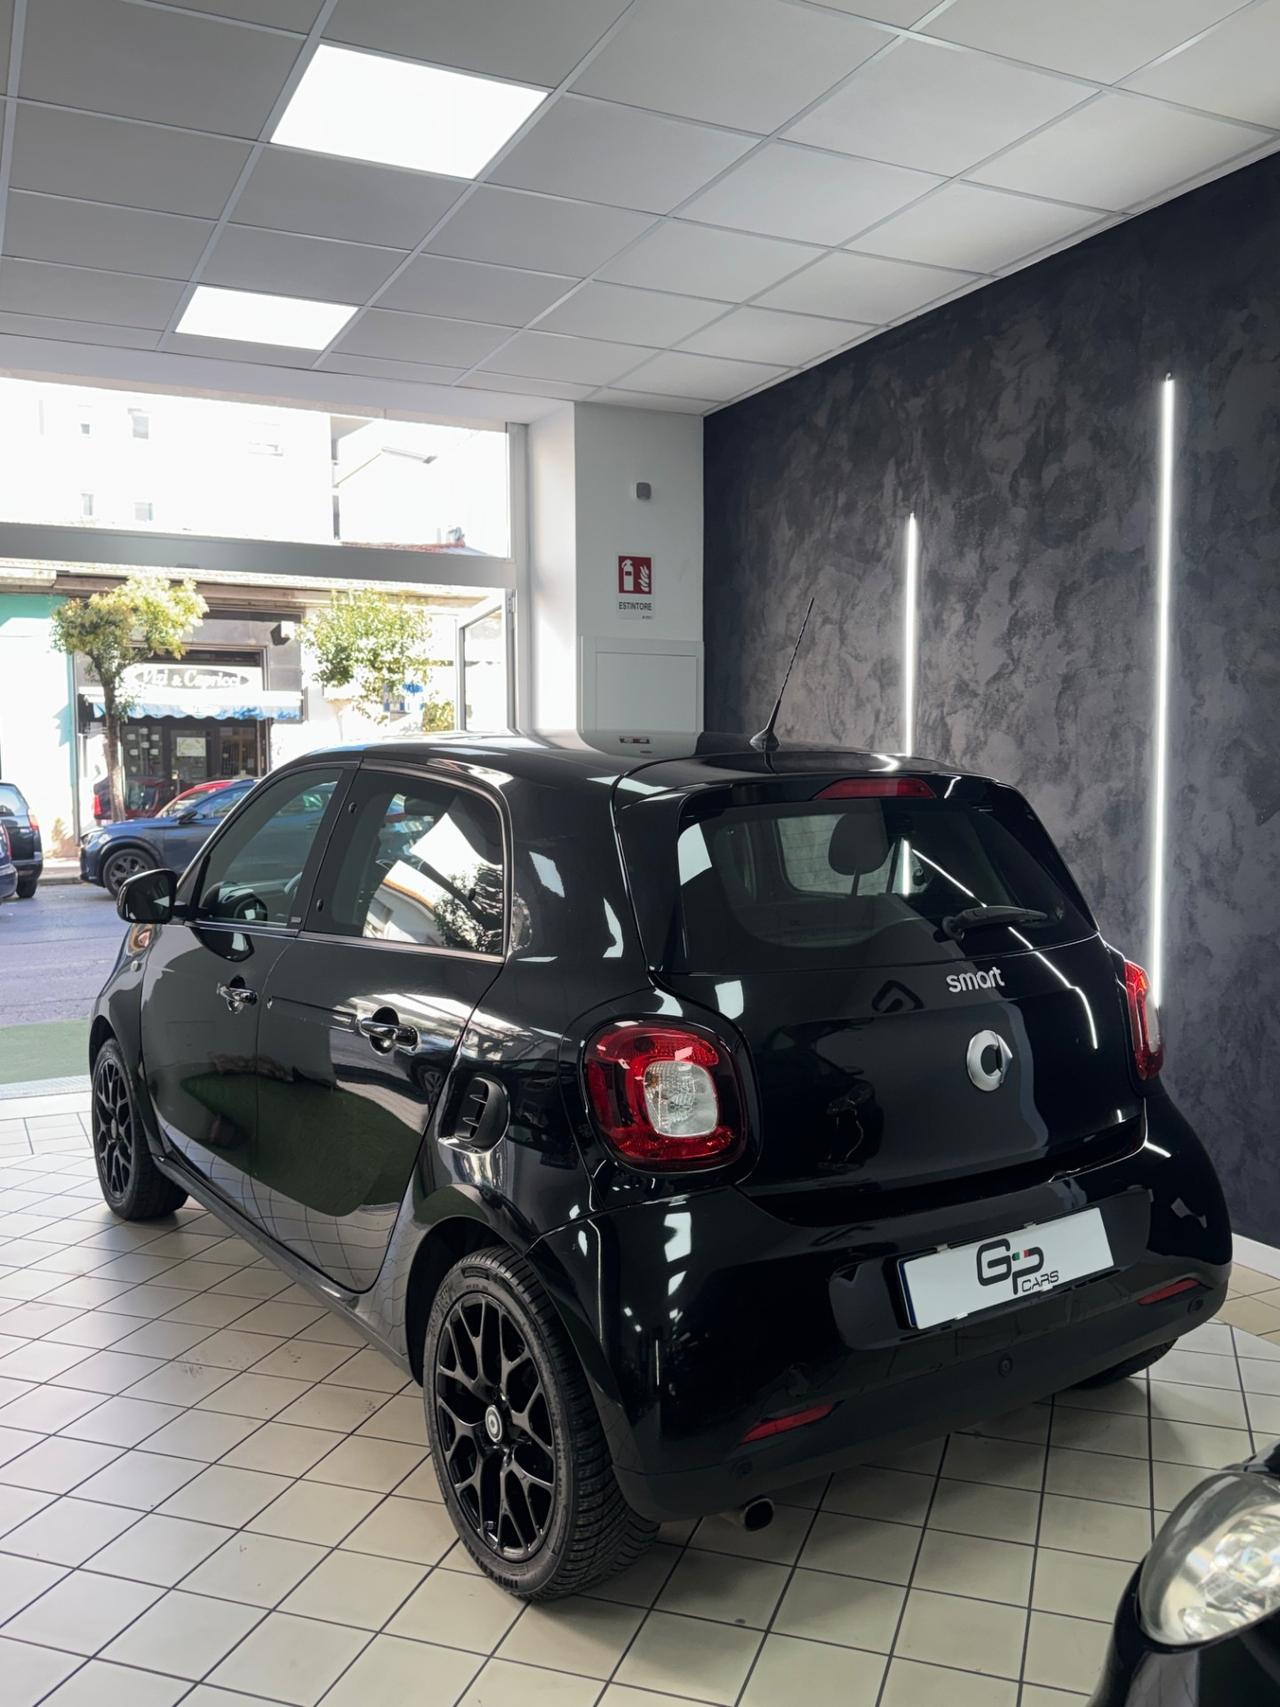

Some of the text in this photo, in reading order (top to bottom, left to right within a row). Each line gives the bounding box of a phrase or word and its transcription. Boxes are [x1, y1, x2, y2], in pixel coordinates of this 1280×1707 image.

[618, 601, 653, 611] ESTINTORE
[946, 966, 1005, 993] smart
[1021, 1270, 1060, 1293] CARS
